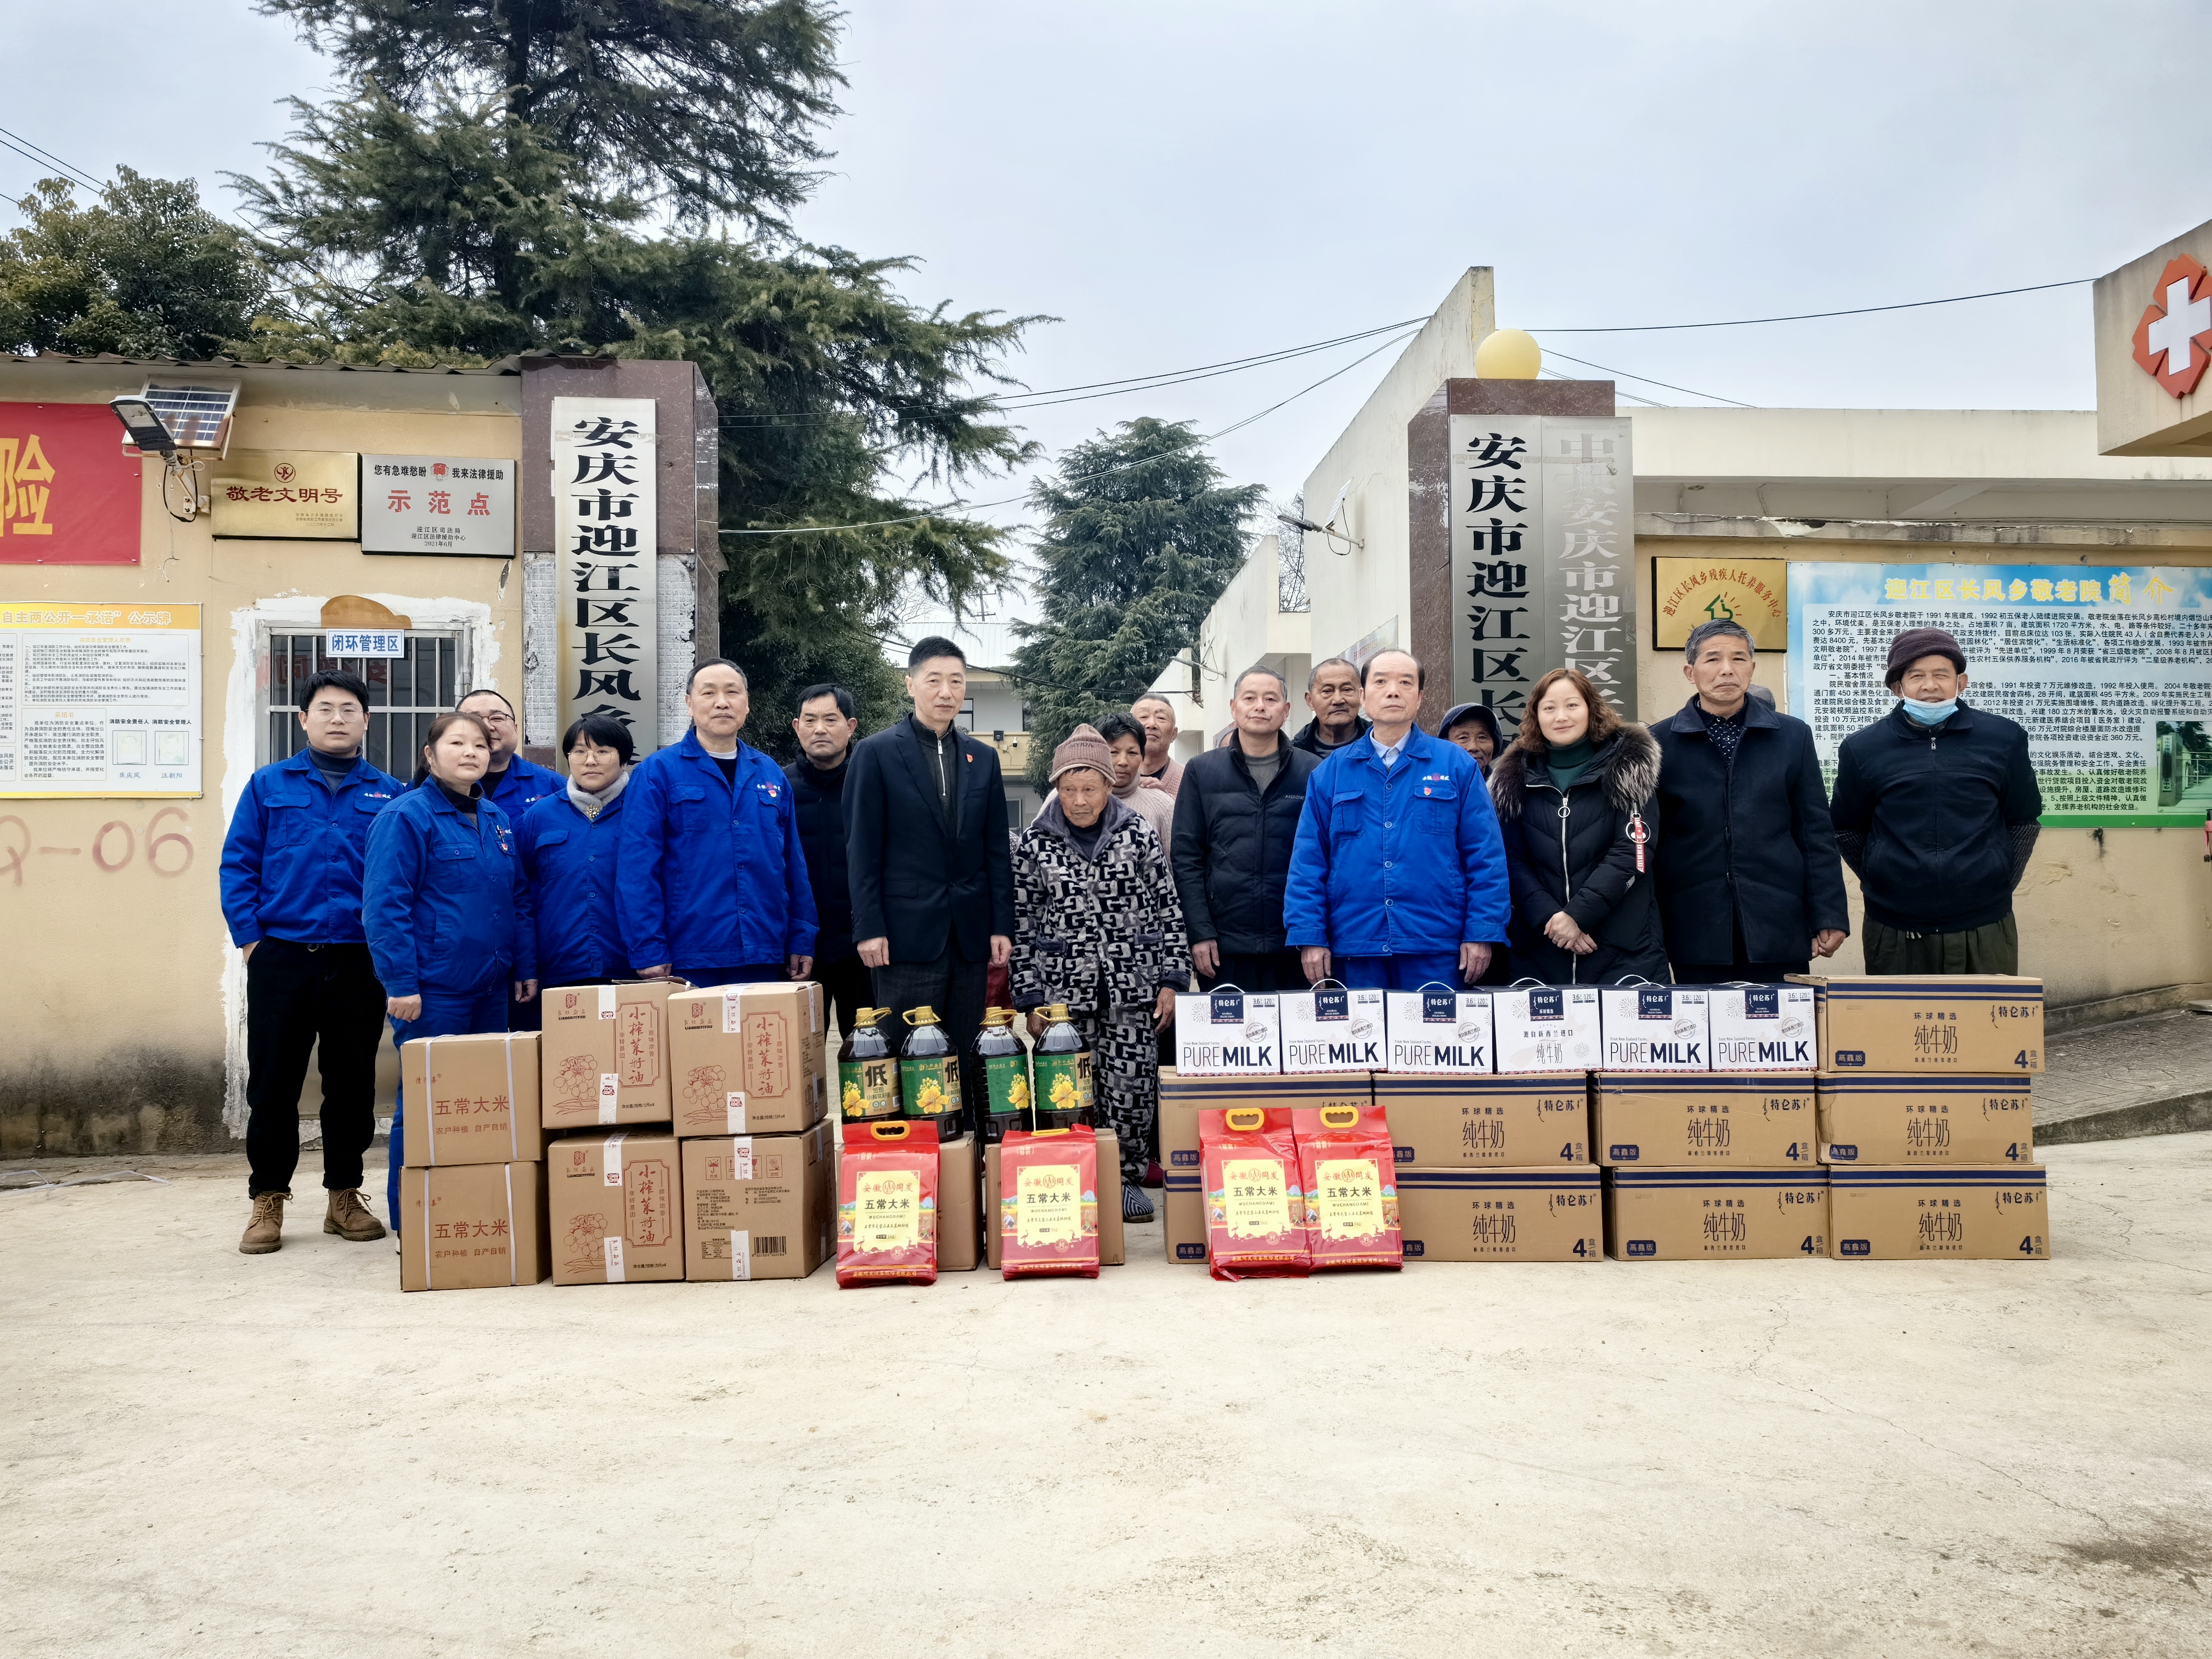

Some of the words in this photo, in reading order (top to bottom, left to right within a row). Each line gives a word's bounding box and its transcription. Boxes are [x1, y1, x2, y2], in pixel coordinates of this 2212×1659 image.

[374, 464, 427, 477] 您有急难愁盼
[452, 467, 504, 480] 我来法律援助
[0, 434, 55, 536] 险
[225, 486, 343, 503] 敬老文明号
[387, 489, 491, 516] 示范点
[411, 532, 466, 541] 迎江区法律援助中心
[417, 525, 462, 534] 迎江区司法局
[1662, 568, 1783, 618] 迎江区长风乡残疾人托养服务中心
[128, 611, 172, 625] 公示牌
[332, 634, 399, 652] 闭环管理区
[1431, 998, 1448, 1006] 特仑苏
[1537, 996, 1554, 1004] 特仑苏
[1753, 994, 1770, 1002] 特仑苏
[1913, 1012, 1957, 1020] 环球精选
[1999, 1006, 2029, 1018] 特仑苏
[1523, 1030, 1573, 1038] 源自新西兰进口
[1914, 1024, 1957, 1054] 纯牛奶
[628, 1006, 646, 1084] 小榨菜籽油
[1610, 1042, 1647, 1063] PURE
[1650, 1043, 1701, 1063] MILK
[1719, 1042, 1755, 1062] PURE
[1758, 1041, 1809, 1062] MILK
[757, 1016, 774, 1096] 小榨菜籽油
[1184, 1046, 1219, 1067] PURE
[1223, 1046, 1272, 1067] MILK
[1289, 1044, 1325, 1065] PURE
[1329, 1042, 1378, 1064] MILK
[1395, 1045, 1431, 1065] PURE
[1435, 1046, 1485, 1066] MILK
[1536, 1043, 1562, 1065] 纯牛奶
[1838, 1054, 1863, 1062] 高鑫版
[2014, 1050, 2028, 1069] 4
[865, 1063, 887, 1088] 低
[945, 1061, 959, 1084] 低
[434, 1095, 510, 1116] 五常大米
[1462, 1107, 1503, 1115] 环球精选
[1545, 1099, 1574, 1111] 特仑苏
[1770, 1099, 1800, 1111] 特仑苏
[1906, 1105, 1948, 1114] 环球精选
[1990, 1098, 2019, 1110] 特仑苏
[436, 1125, 468, 1135] 农户种植
[475, 1124, 508, 1132] 自产自销
[1462, 1120, 1505, 1149] 纯牛奶
[1688, 1117, 1730, 1147] 纯牛奶
[1907, 1117, 1950, 1147] 纯牛奶
[1173, 1154, 1197, 1162] 高鑫版
[1560, 1142, 1574, 1161] 4
[1613, 1148, 1636, 1156] 高鑫版
[1785, 1142, 1799, 1161] 4
[1831, 1147, 1856, 1156] 高鑫版
[1026, 1192, 1071, 1204] 五常大米
[1233, 1186, 1278, 1197] 五常大米
[1327, 1187, 1372, 1198] 五常大米
[1785, 1192, 1815, 1204] 特仑苏
[2002, 1192, 2034, 1204] 特仑苏
[638, 1164, 656, 1244] 小榨菜籽油
[865, 1198, 910, 1210] 五常大米
[1556, 1195, 1587, 1206] 特仑苏
[1703, 1199, 1744, 1208] 环球精选
[1918, 1199, 1961, 1207] 环球精选
[434, 1219, 508, 1239] 五常大米
[1473, 1214, 1515, 1243] 纯牛奶
[1703, 1212, 1745, 1242] 纯牛奶
[1919, 1212, 1962, 1242] 纯牛奶
[435, 1249, 468, 1258] 农户种植
[474, 1247, 507, 1256] 自产自销
[1179, 1246, 1203, 1255] 高鑫版
[1573, 1238, 1587, 1257] 4
[1629, 1244, 1654, 1252] 高鑫版
[2019, 1236, 2034, 1255] 4
